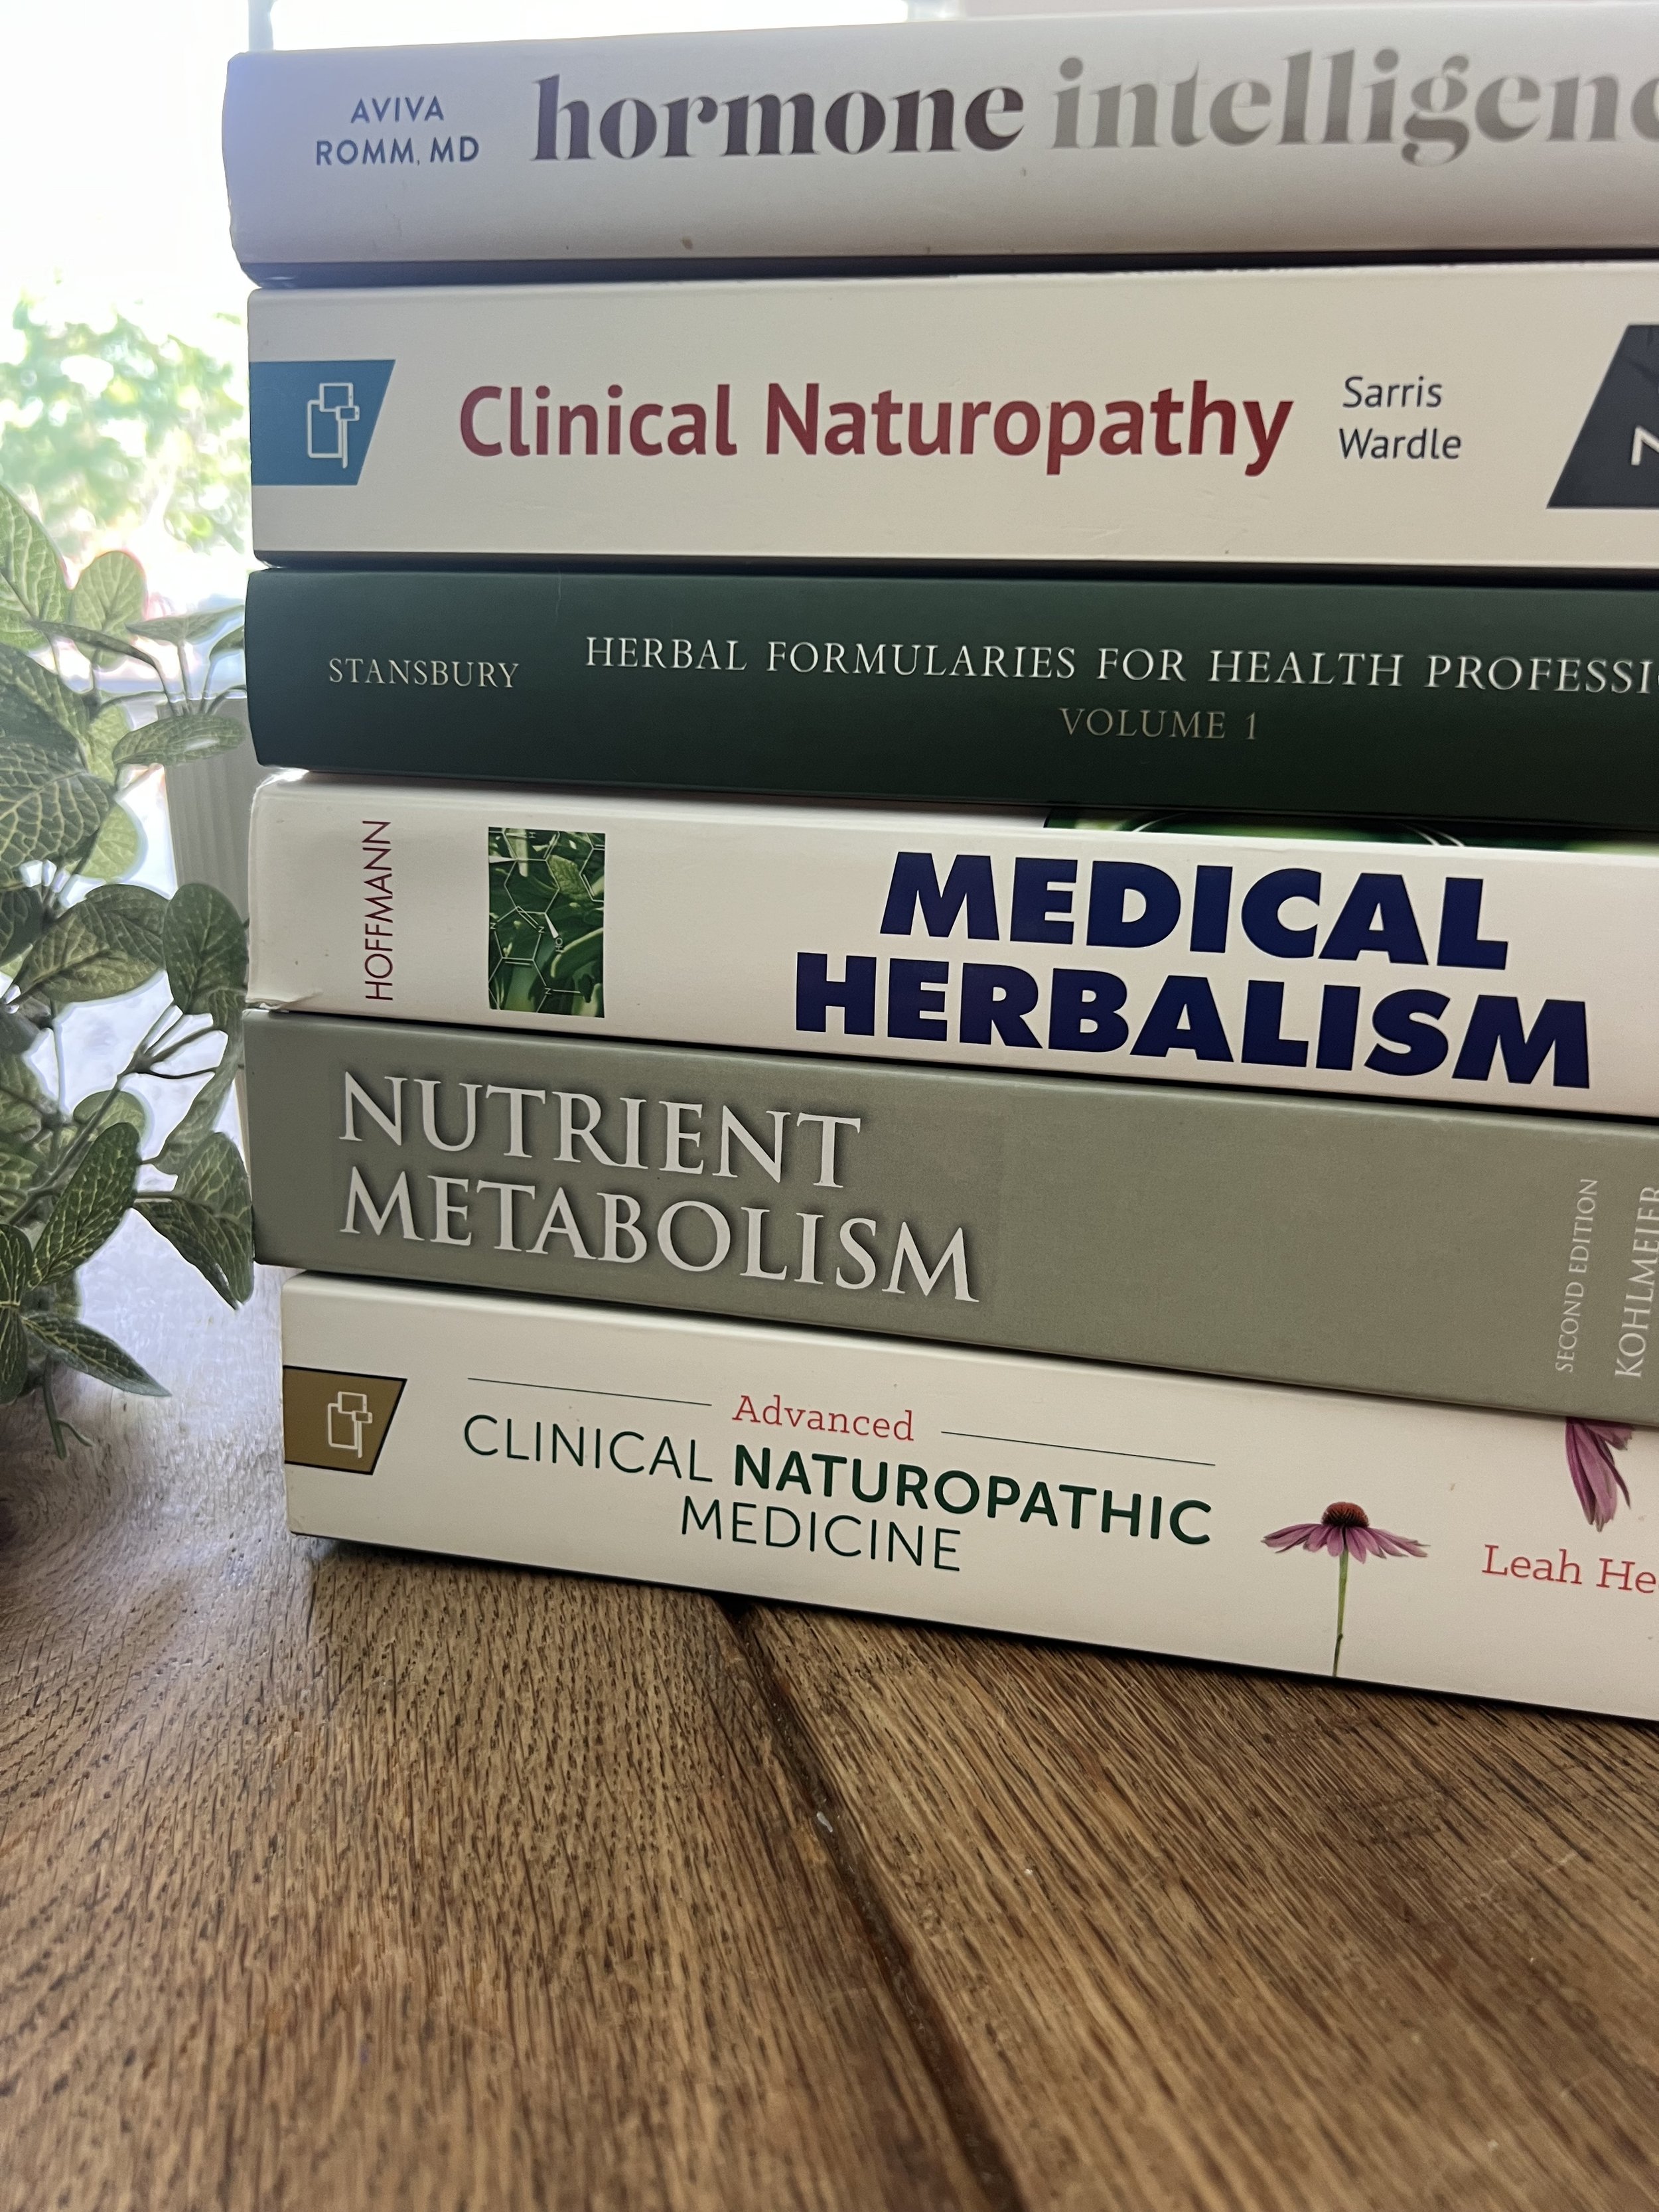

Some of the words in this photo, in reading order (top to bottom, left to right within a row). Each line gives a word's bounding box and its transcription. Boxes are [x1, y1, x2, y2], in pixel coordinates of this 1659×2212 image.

[316, 137, 420, 166] ROMM,
[429, 135, 479, 163] MD
[350, 96, 444, 123] AVIVA
[534, 74, 1024, 161] hormone
[460, 384, 738, 457] Clinical
[766, 380, 1294, 477] Naturopathy
[1342, 375, 1443, 408] Sarris
[1338, 427, 1462, 460] Wardle
[328, 658, 519, 688] STANSBURY
[587, 636, 746, 670] HERBAL
[768, 641, 1075, 678] FORMULARIES
[1098, 648, 1185, 681] FOR
[1210, 650, 1404, 686] HEALTH
[1427, 655, 1659, 694] PROFESSI
[1059, 707, 1225, 739] VOLUME
[1245, 711, 1258, 741] 1
[362, 820, 394, 1001] HOFFMANN
[879, 851, 1508, 970] MEDICAL
[795, 952, 1591, 1088] HERBALISM
[338, 1071, 863, 1189] NUTRIENT
[338, 1166, 980, 1303] METABOLISM
[1568, 1179, 1598, 1274] EDITION
[1555, 1282, 1585, 1373] SECOND
[731, 1394, 914, 1443] Advanced
[464, 1414, 713, 1483] CLINICAL
[733, 1444, 1211, 1546] NATUROPATHIC
[681, 1495, 962, 1573] MEDICINE
[1481, 1544, 1583, 1585] Leah
[1595, 1557, 1659, 1594] He
